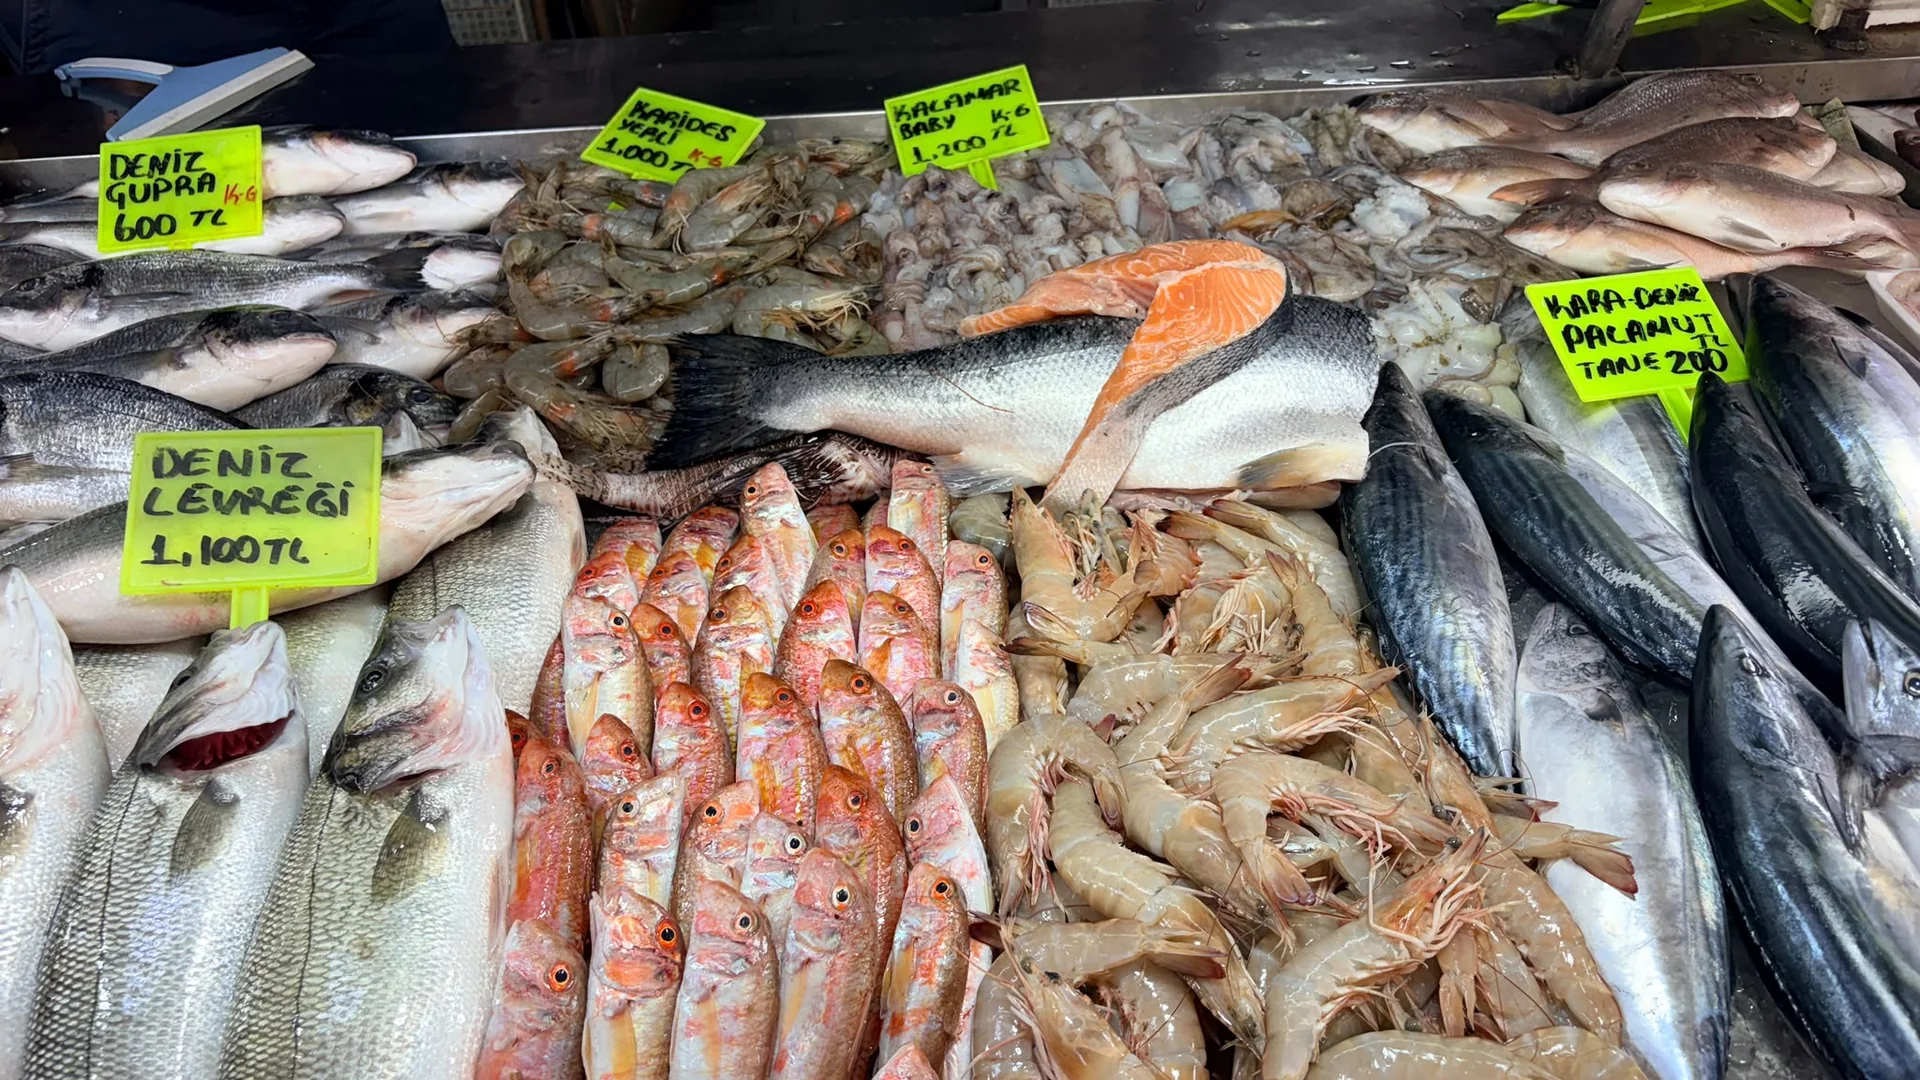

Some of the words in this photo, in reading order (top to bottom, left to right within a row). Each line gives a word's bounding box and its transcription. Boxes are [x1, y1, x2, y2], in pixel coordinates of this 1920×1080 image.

[893, 78, 1022, 123] KALAMAR
[628, 99, 737, 142] KARİDES
[899, 114, 956, 141] BABY
[990, 123, 1018, 141] TL
[110, 148, 207, 180] DENİZ
[105, 172, 216, 210] GUPRA
[114, 213, 177, 242] 600
[189, 208, 228, 227] TL
[1561, 312, 1714, 354] PALAMUT
[1575, 351, 1662, 380] TANE
[1664, 348, 1729, 375] 200
[152, 444, 313, 479] DENİZ
